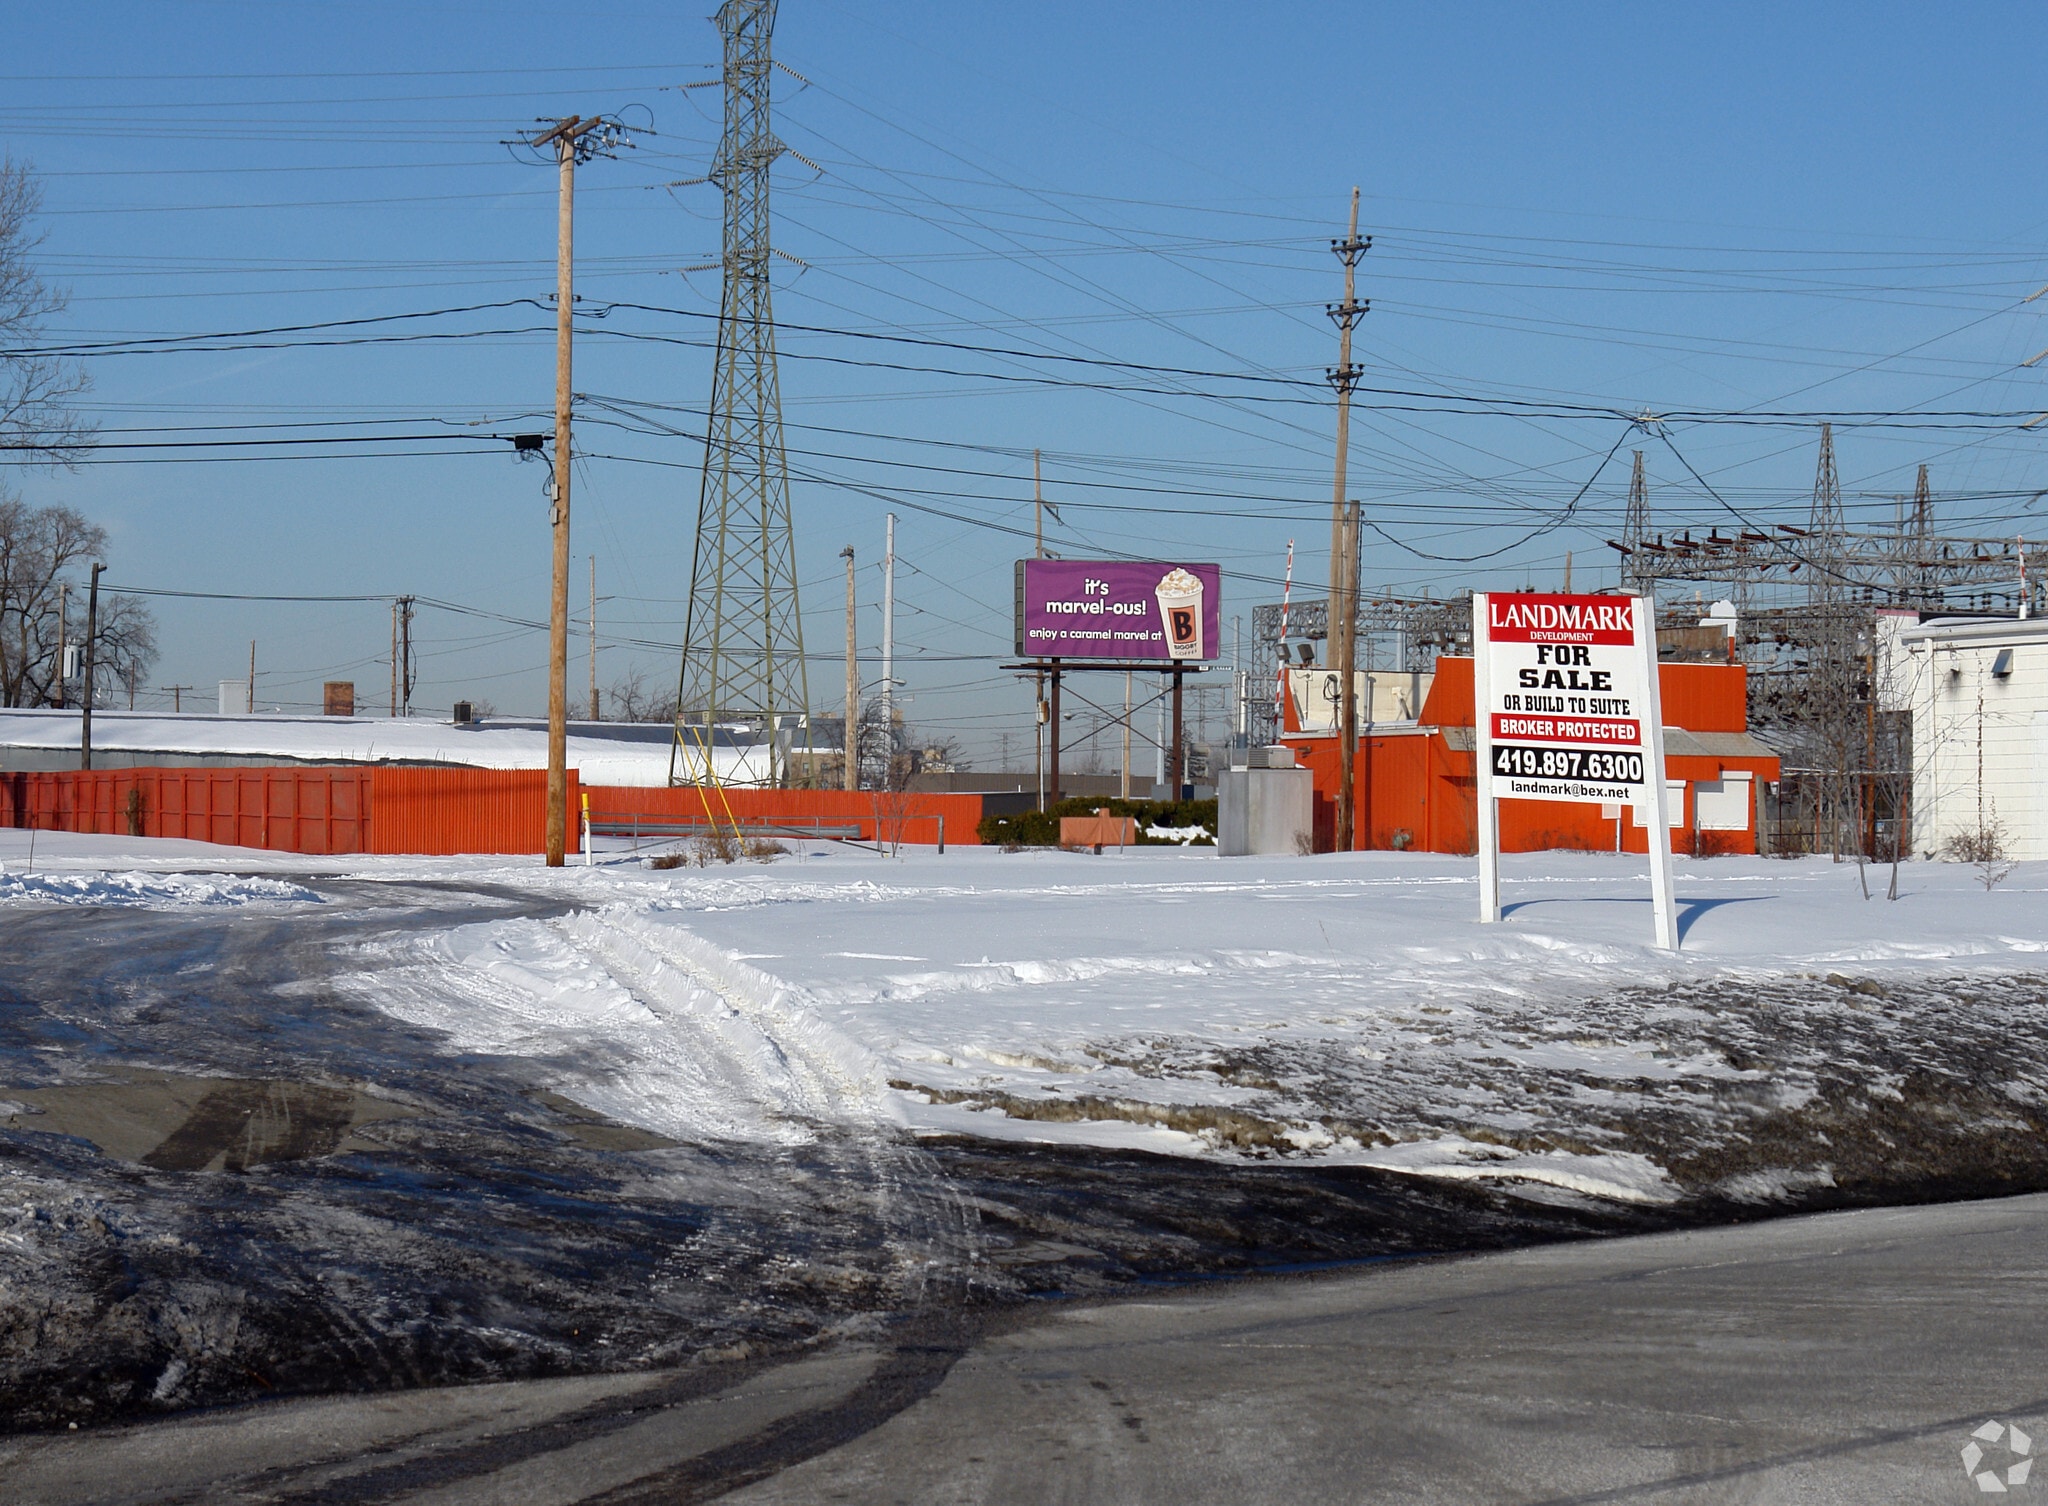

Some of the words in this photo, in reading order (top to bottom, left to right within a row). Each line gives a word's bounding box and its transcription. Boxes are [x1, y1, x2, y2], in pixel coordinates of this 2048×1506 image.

[1085, 578, 1109, 595] it's
[1046, 598, 1147, 615] marvel-ous!
[1491, 604, 1632, 630] LANDMARK
[1029, 628, 1057, 640] enjoy
[1060, 631, 1067, 639] a
[1070, 629, 1112, 640] caramel
[1114, 629, 1149, 640] marvel
[1151, 630, 1162, 640] at
[1174, 611, 1193, 641] B
[1530, 631, 1594, 642] DEVELOPMENT
[1537, 644, 1591, 666] FOR
[1519, 669, 1612, 691] SALE
[1504, 694, 1521, 711] OR
[1525, 695, 1565, 713] BUILD
[1568, 697, 1587, 714] TO
[1590, 698, 1631, 716] SUITE
[1500, 719, 1554, 736] BROKER
[1558, 721, 1636, 740] PROTECTED
[1497, 749, 1642, 780] 419.897.6300
[1511, 780, 1630, 798] landmark@bex.net
